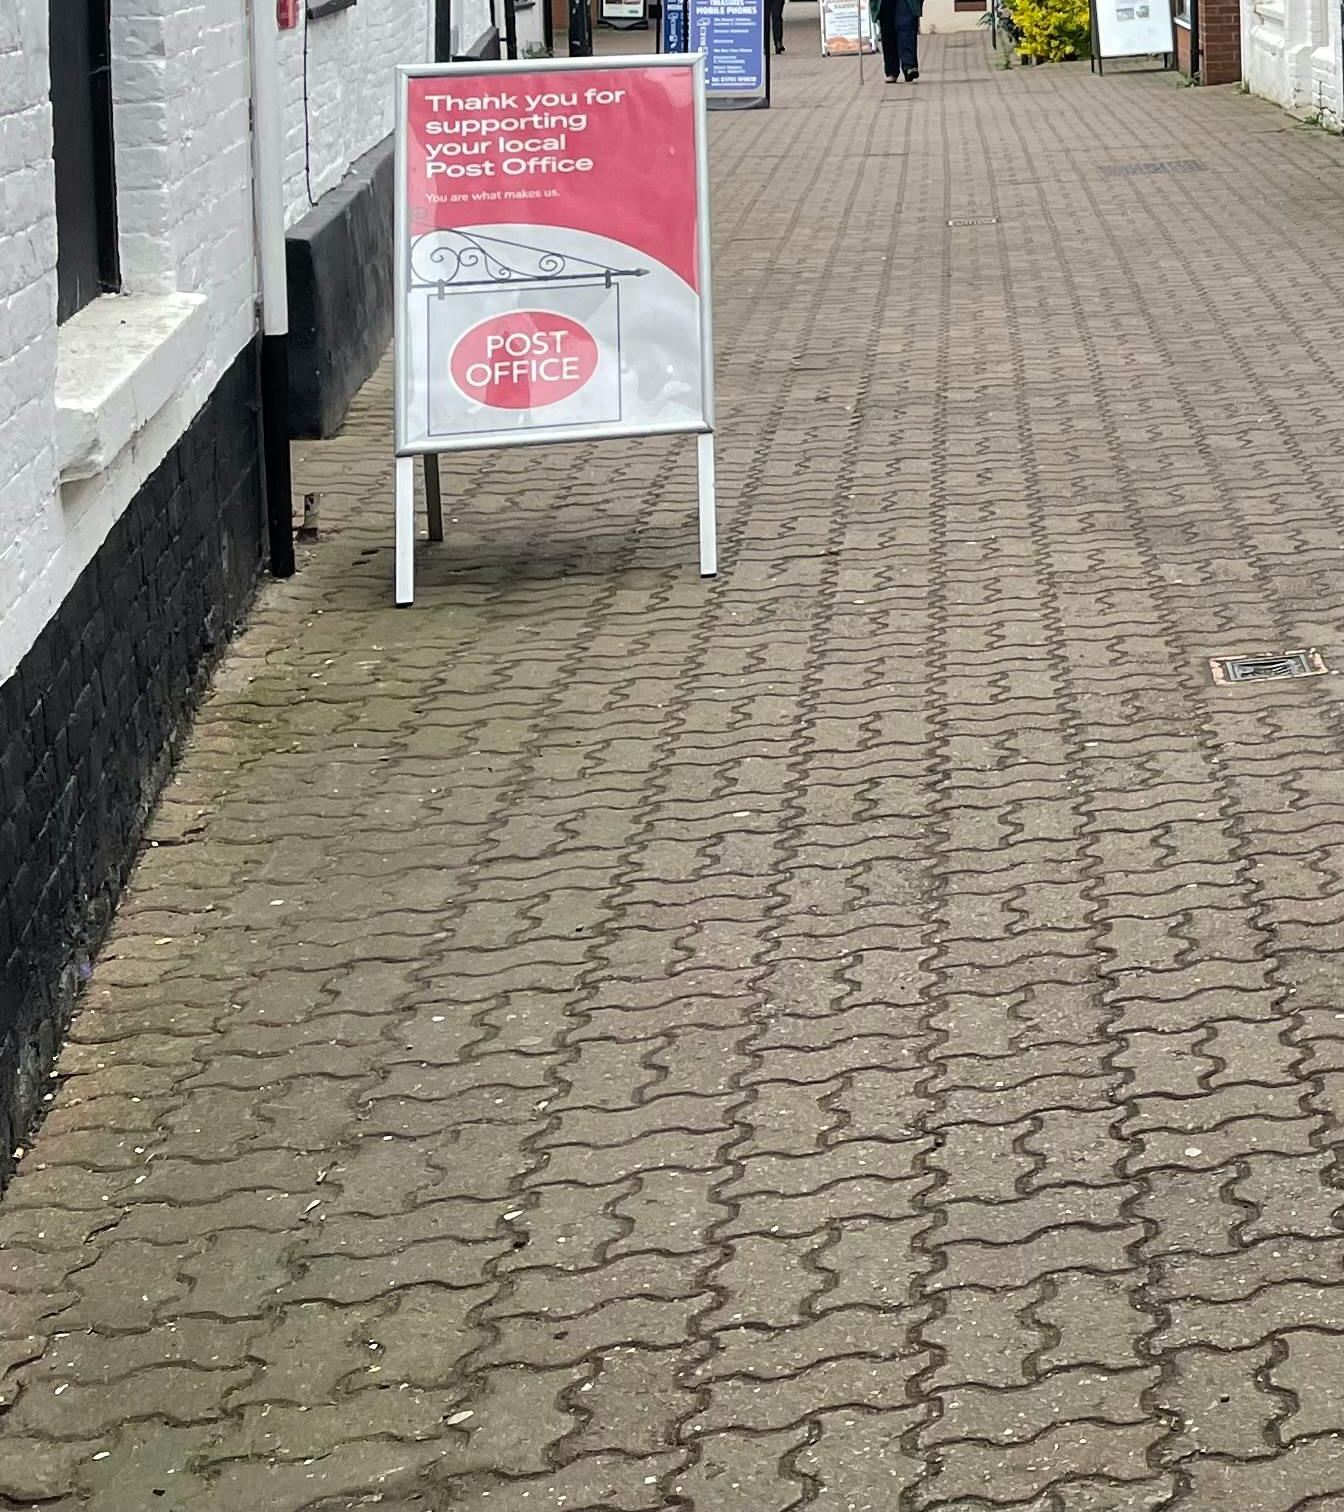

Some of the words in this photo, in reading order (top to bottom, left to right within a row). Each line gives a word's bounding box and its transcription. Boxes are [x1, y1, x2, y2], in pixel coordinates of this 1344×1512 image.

[696, 6, 725, 15] MOBILE
[726, 6, 757, 15] PHONES
[425, 92, 518, 112] Thank
[525, 92, 577, 112] you
[584, 88, 625, 105] for
[425, 112, 587, 136] supporting
[425, 140, 492, 160] your
[499, 134, 566, 153] local
[426, 159, 495, 179] Post
[502, 156, 594, 175] Office
[425, 193, 448, 203] You
[450, 193, 469, 202] are
[472, 190, 502, 201] what
[504, 189, 541, 200] makes
[544, 188, 560, 198] us.
[486, 330, 569, 359] POST
[466, 356, 580, 387] OFFICE
